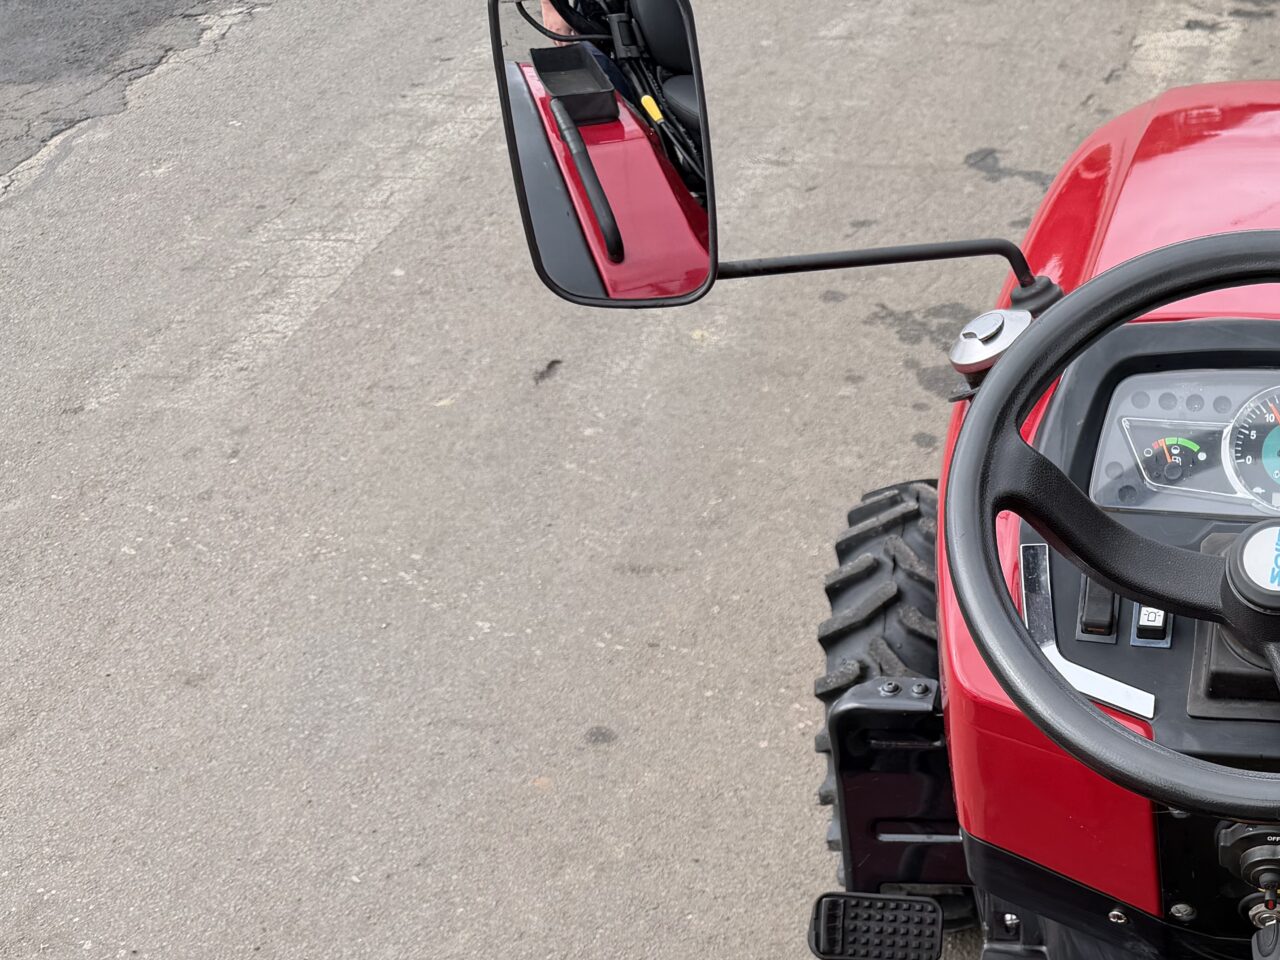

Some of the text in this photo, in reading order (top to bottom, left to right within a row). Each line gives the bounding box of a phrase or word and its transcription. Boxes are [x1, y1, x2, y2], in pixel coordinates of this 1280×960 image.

[1265, 413, 1275, 422] 10
[1250, 431, 1256, 439] 5
[1246, 456, 1252, 464] 0
